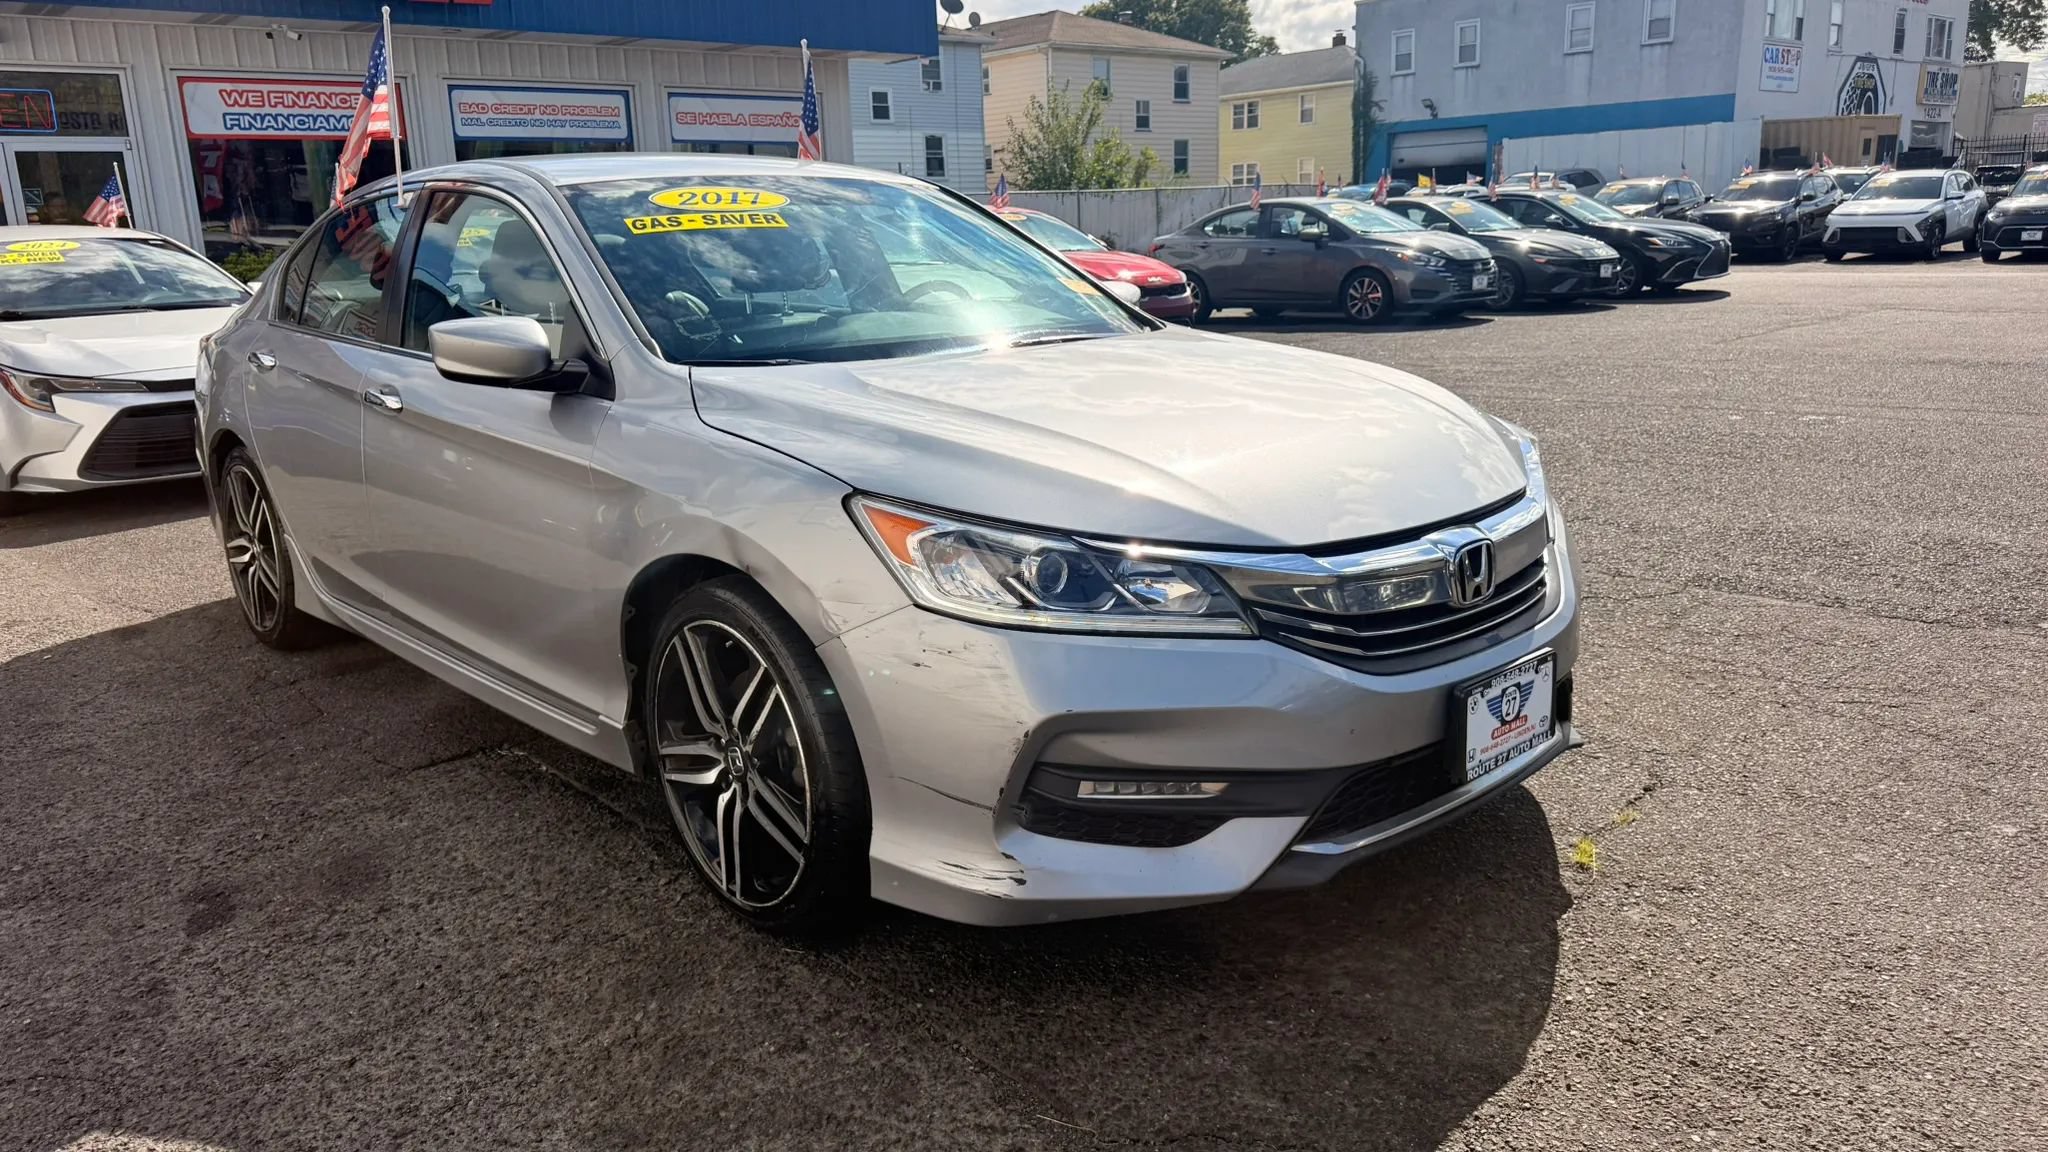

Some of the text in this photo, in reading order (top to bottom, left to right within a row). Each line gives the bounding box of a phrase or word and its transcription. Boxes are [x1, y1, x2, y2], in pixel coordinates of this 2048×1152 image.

[1764, 47, 1779, 64] CAR
[1926, 71, 1958, 89] TIRE SHOP
[219, 89, 361, 109] WE FINANCE
[459, 103, 620, 117] BAD CREDIT NO PROBLEM
[461, 117, 621, 129] MAL CREDITO NO HAY PROBLEMA
[676, 112, 801, 127] SE HABLA ESPAÑO
[678, 191, 762, 206] 2017
[631, 216, 682, 231] GAS
[703, 213, 781, 226] SAVER
[1505, 696, 1517, 717] 27
[1493, 716, 1526, 739] AUTO MALL
[1467, 731, 1552, 781] ROUTE 27 AUTO MALL
